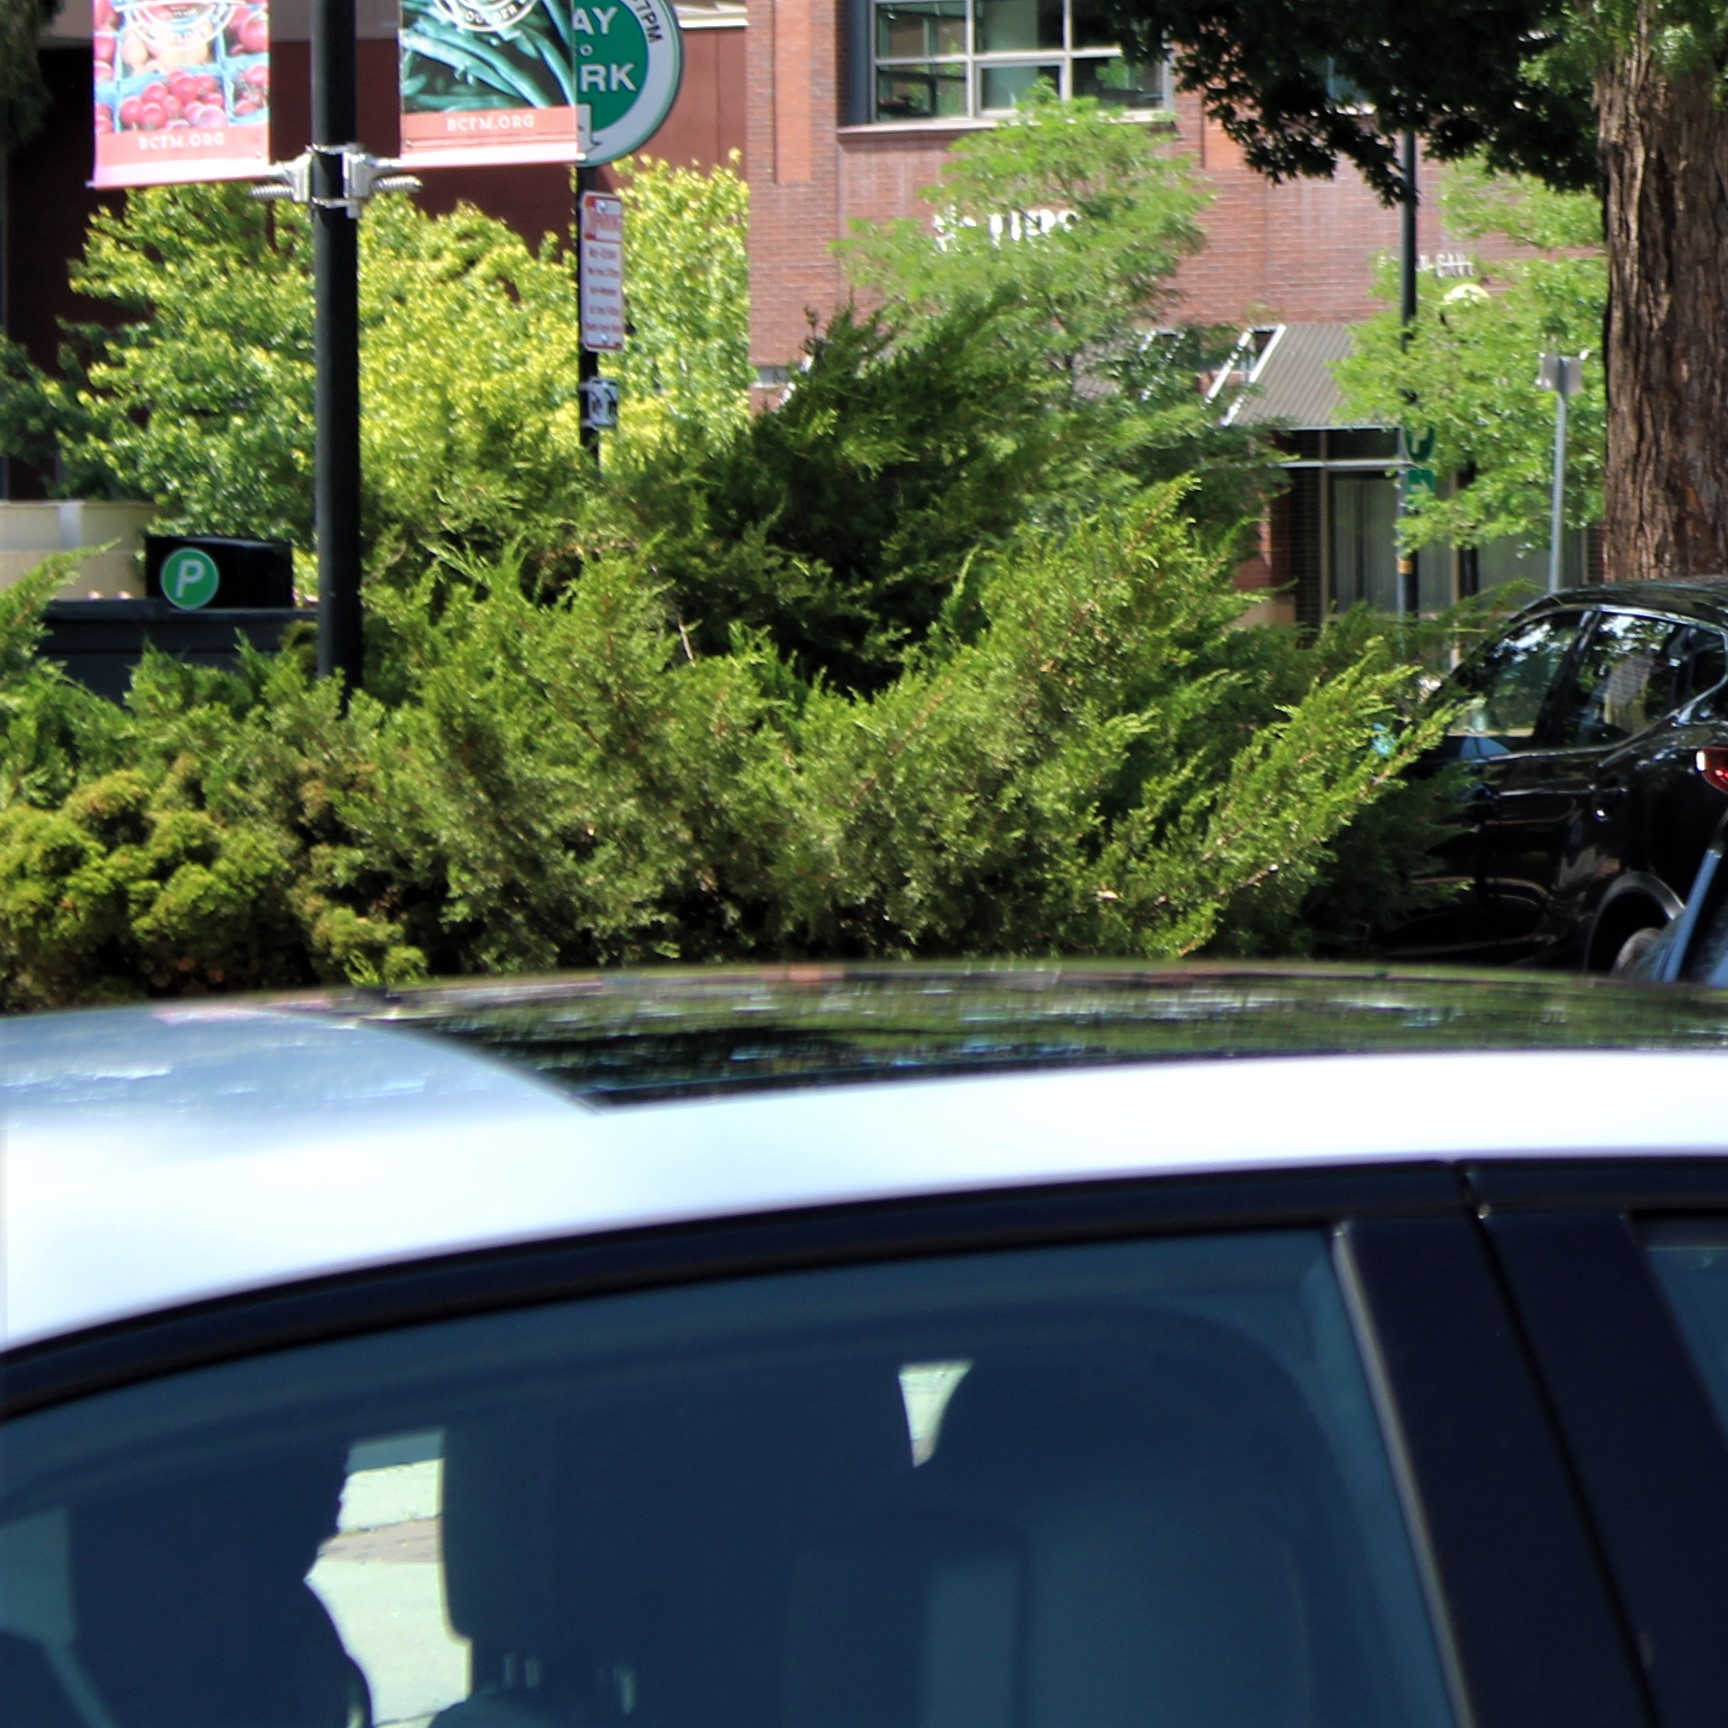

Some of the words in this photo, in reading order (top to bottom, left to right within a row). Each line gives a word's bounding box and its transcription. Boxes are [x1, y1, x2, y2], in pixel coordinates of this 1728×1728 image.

[573, 6, 619, 36] AY
[636, 0, 664, 44] 7PM
[580, 62, 637, 93] RK
[446, 114, 535, 133] BCFM.ORG
[137, 132, 225, 151] BCFM.ORG
[175, 559, 206, 599] P
